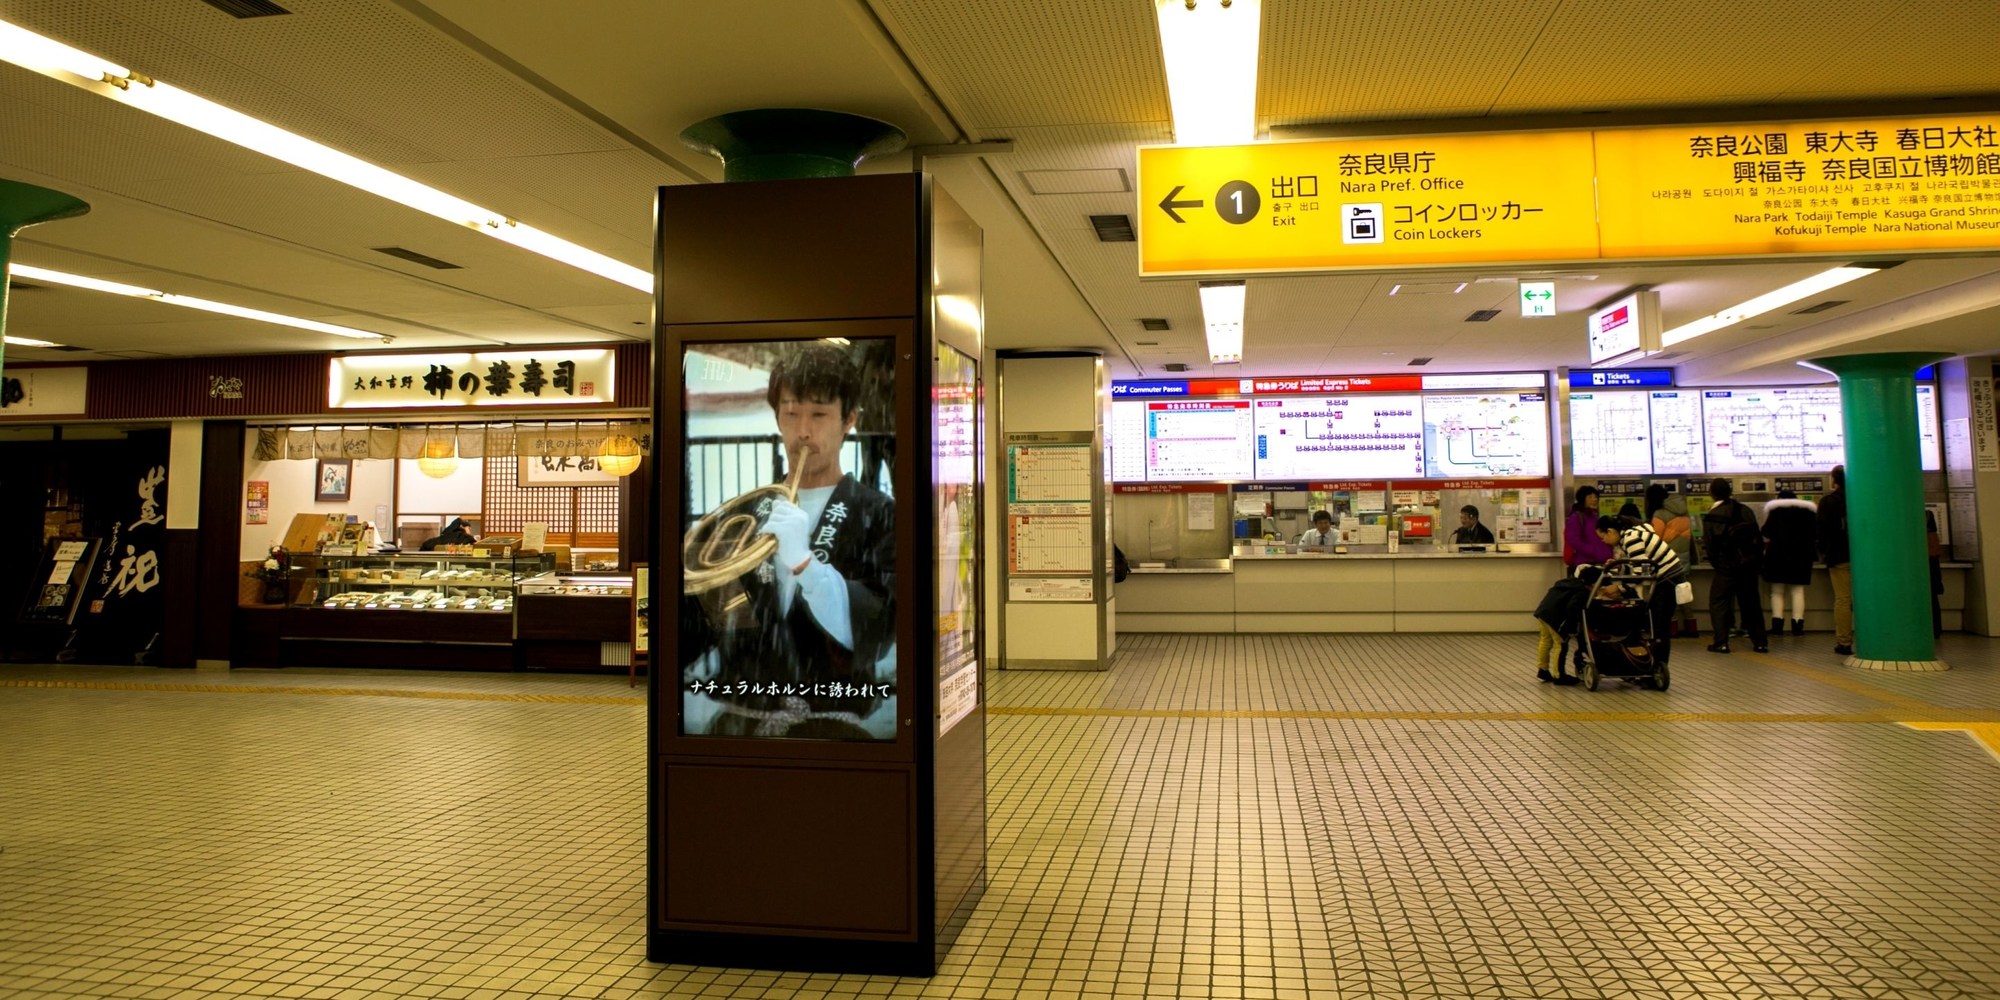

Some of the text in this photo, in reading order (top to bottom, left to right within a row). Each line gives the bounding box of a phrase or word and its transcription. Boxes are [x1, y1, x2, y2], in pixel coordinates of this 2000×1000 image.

[1689, 124, 1999, 159] 奈良公園 東大寺 春日大社
[1339, 150, 1436, 177] 奈良県庁
[1733, 152, 2000, 184] 興福寺 奈良国立博物館
[1271, 175, 1318, 199] 出口
[1340, 177, 1464, 194] Nara Pref. Office
[1652, 189, 1692, 200] 나라공원
[1703, 187, 1744, 198] 도다이지
[1229, 189, 1243, 215] 1
[1272, 202, 1292, 213] 출구
[1299, 201, 1319, 212] 出口
[1851, 196, 1891, 207] 春日大社
[1394, 200, 1544, 224] コインロッカー
[1734, 205, 2000, 224] Nara Park Todaiji Temple Kasuga Grand Shrin
[1272, 216, 1296, 226] Exit
[1775, 225, 1822, 238] Kofukuji
[1824, 223, 1867, 236] Temple
[1873, 222, 1901, 233] Nara
[1903, 220, 1953, 232] National
[1393, 226, 1482, 241] Coin Lockers
[354, 374, 414, 391] 大和吉野
[1607, 372, 1630, 380] Tickets
[1111, 385, 1127, 393] りば
[690, 680, 891, 698] ナチュラルホルンに誘われて
